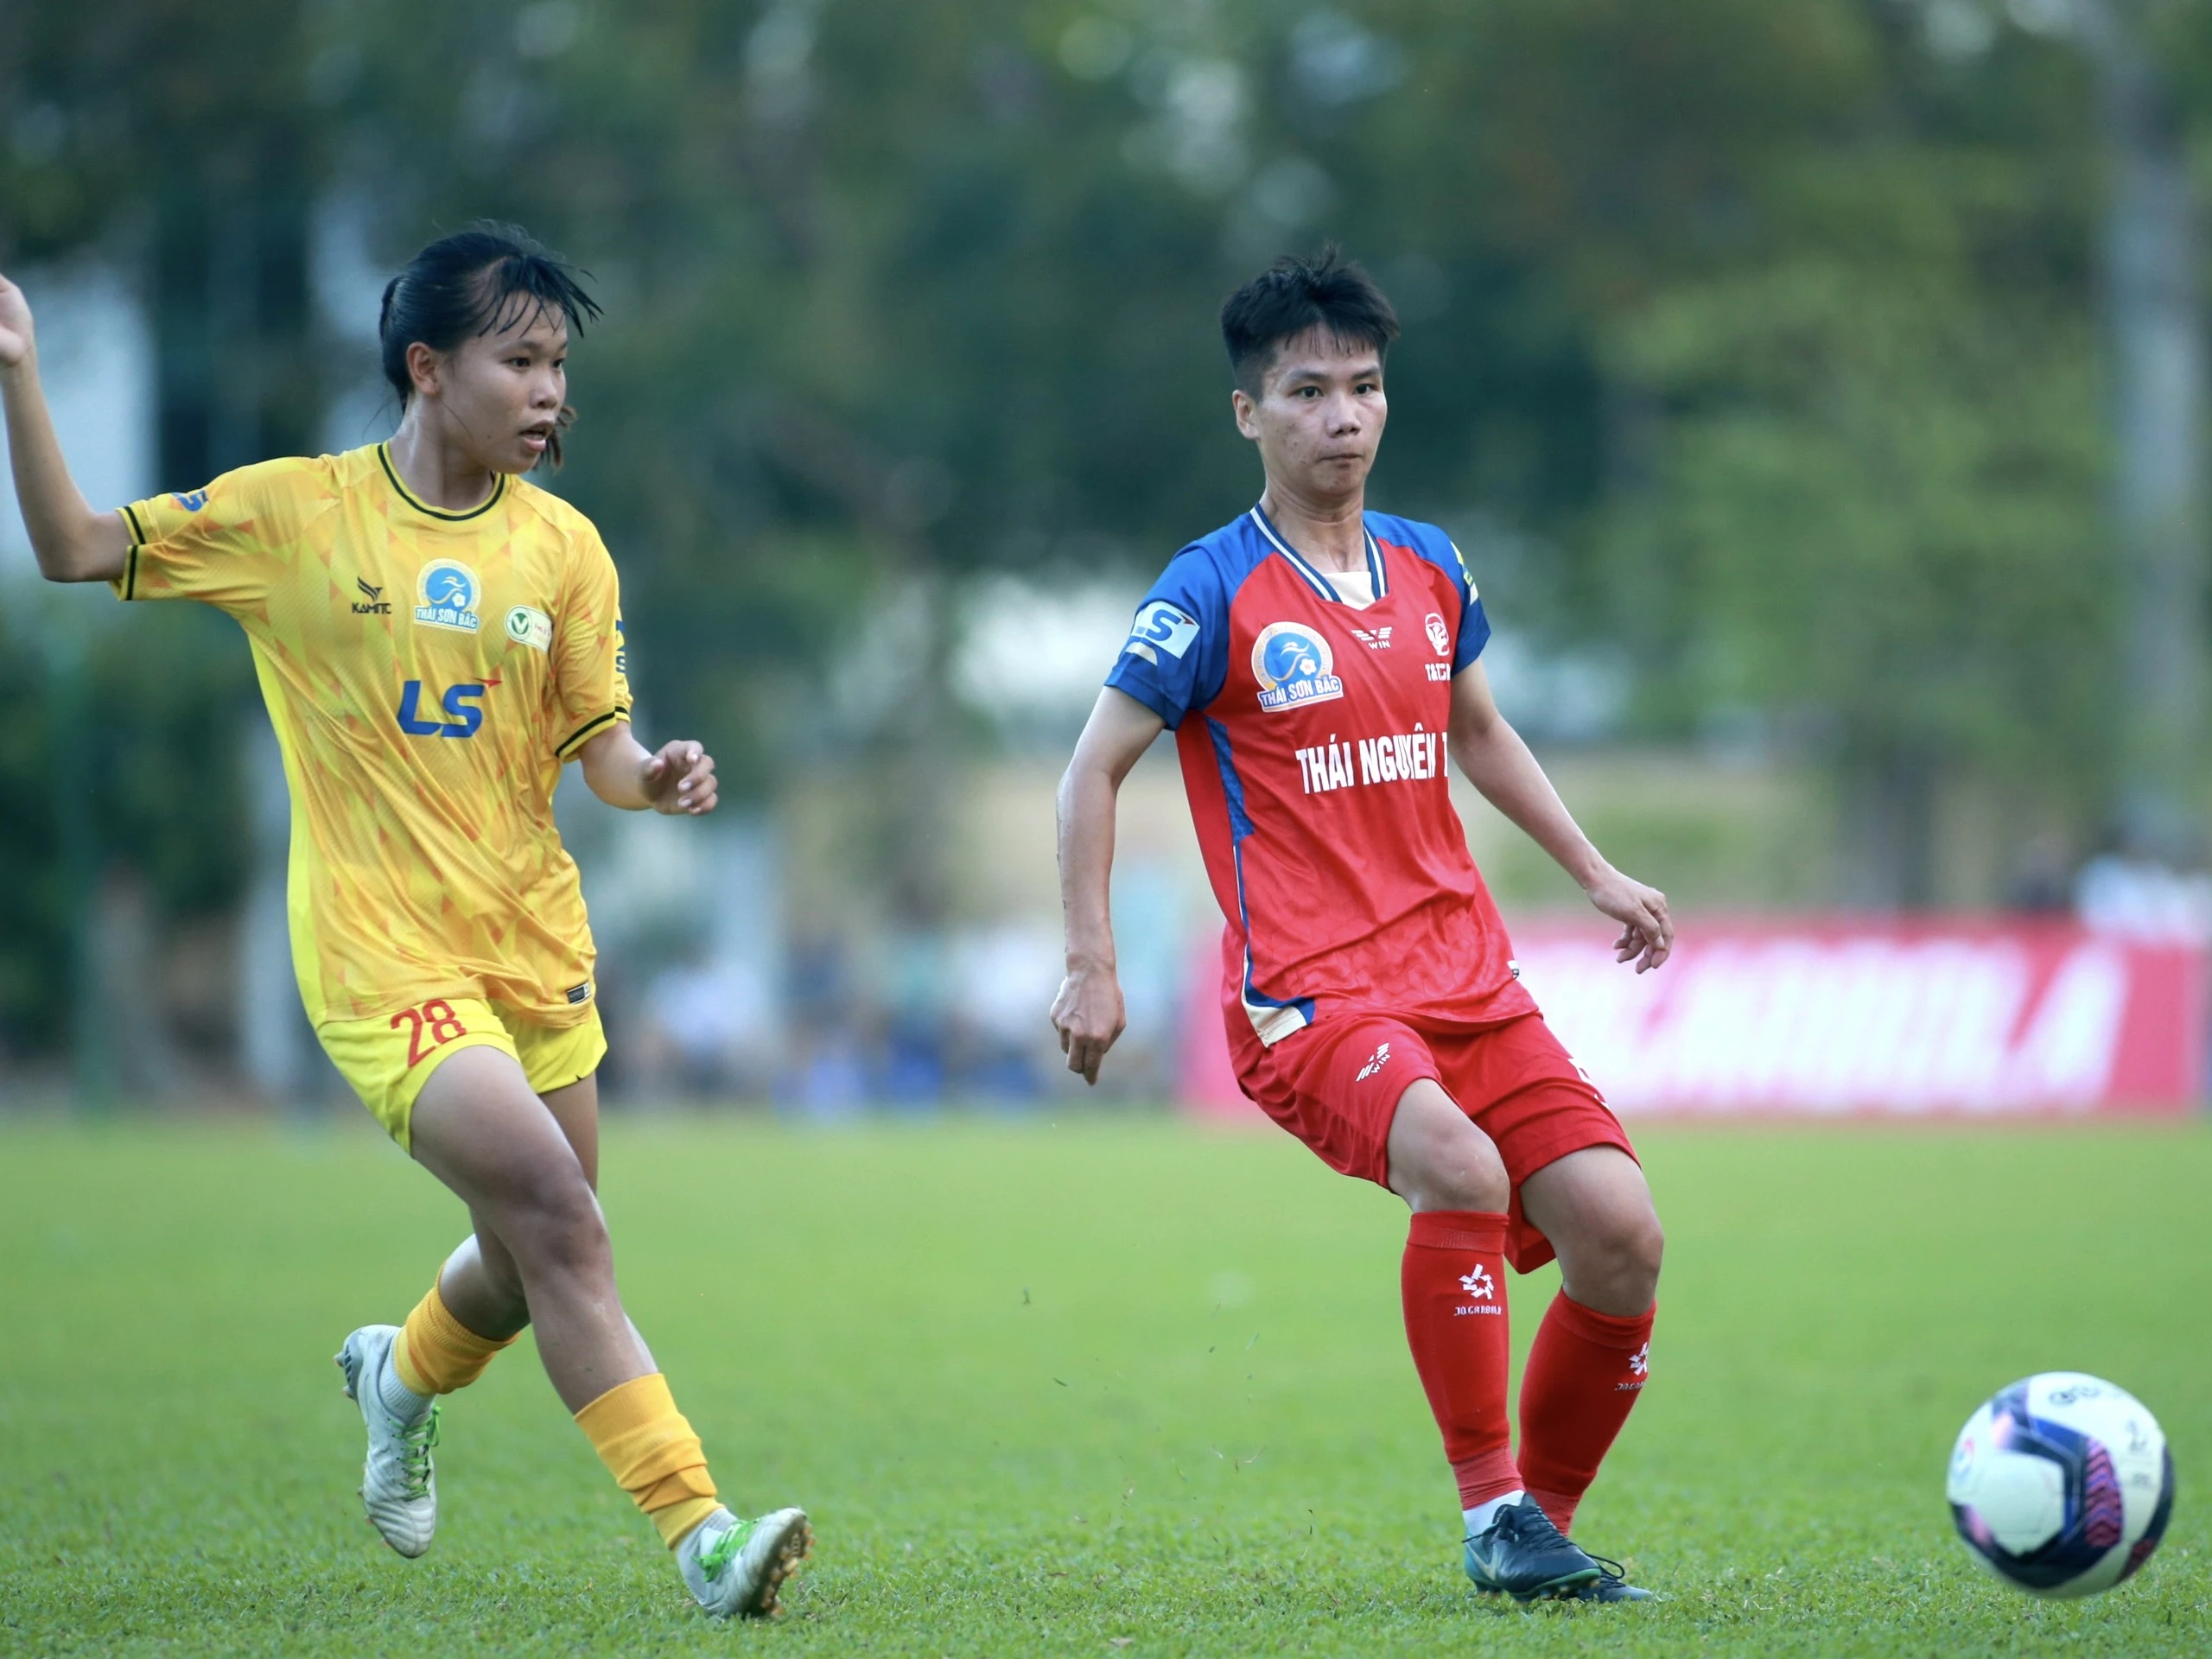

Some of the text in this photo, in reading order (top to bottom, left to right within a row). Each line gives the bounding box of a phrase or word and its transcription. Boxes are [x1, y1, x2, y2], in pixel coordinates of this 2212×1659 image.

[437, 607, 457, 624] SƠN
[1368, 639, 1391, 650] WIN
[1261, 685, 1287, 706] THÁI
[1288, 679, 1314, 700] SƠN
[397, 680, 486, 738] LS
[1294, 733, 1355, 795] THÁI
[1358, 722, 1436, 785] NGUYÊN
[390, 999, 467, 1068] 28
[1370, 1053, 1391, 1073] WIN
